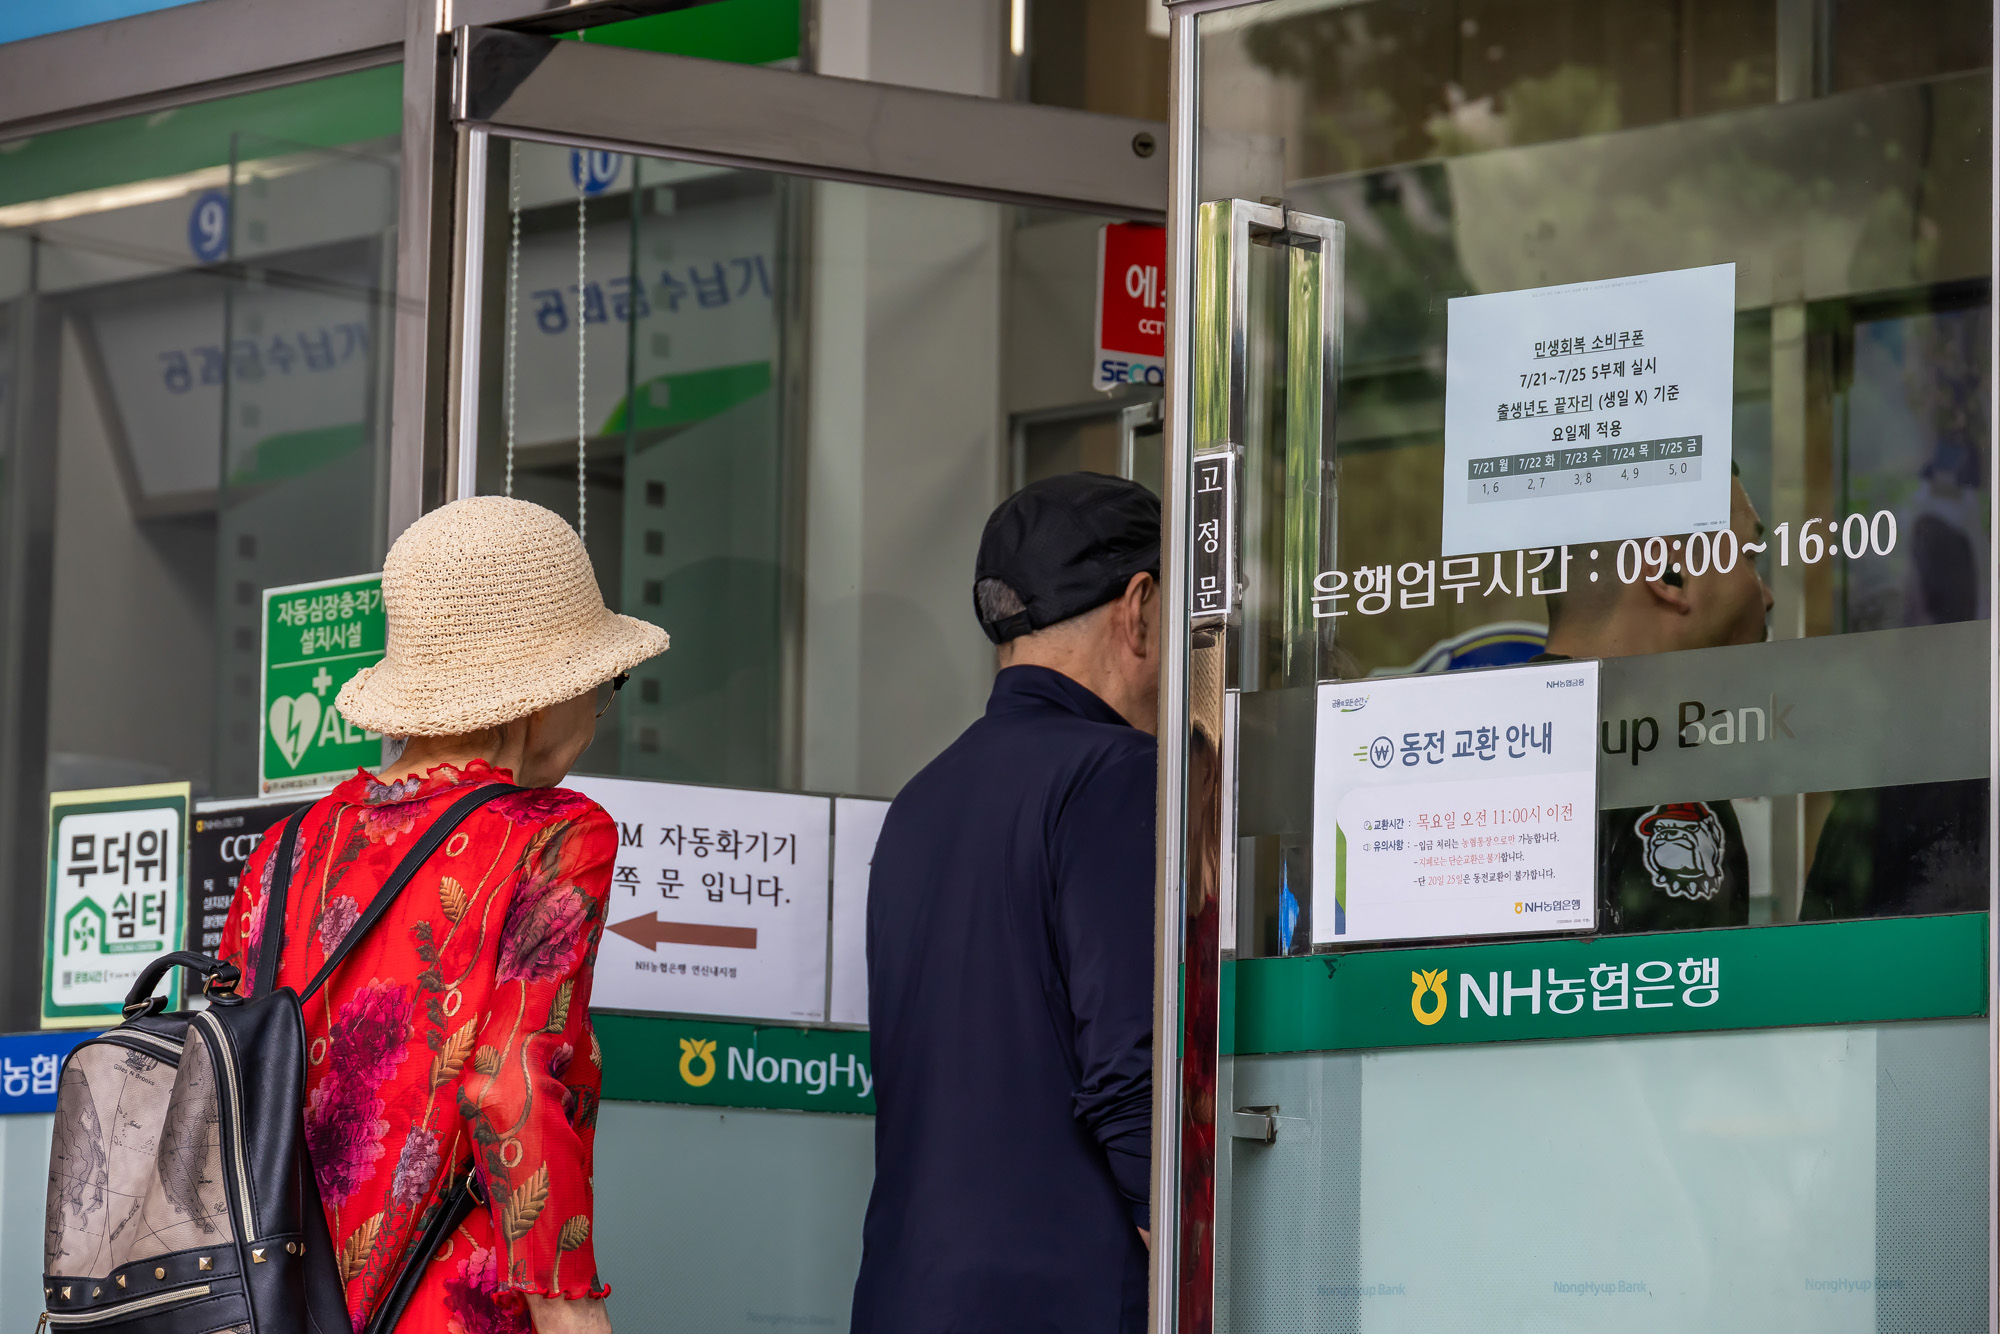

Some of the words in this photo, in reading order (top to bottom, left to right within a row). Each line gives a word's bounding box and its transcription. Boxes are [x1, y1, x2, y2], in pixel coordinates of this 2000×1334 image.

[199, 199, 224, 249] 9
[1125, 264, 1166, 309] 에
[1138, 319, 1165, 335] CCT
[1534, 336, 1586, 358] 민생회복
[1591, 329, 1644, 350] 소비쿠폰
[1101, 360, 1164, 385] SECO
[1520, 367, 1586, 389] 7/21~7/25
[1591, 360, 1625, 379] 5부제
[1631, 357, 1657, 376] 실시
[1497, 400, 1548, 420] 출생년도
[1554, 394, 1593, 413] 끝자리
[1599, 389, 1629, 410] (생일
[1634, 390, 1648, 409] X)
[1653, 384, 1680, 402] 기준
[1552, 423, 1590, 441] 요일제
[1596, 420, 1622, 437] 적용
[1473, 463, 1494, 475] 7/21
[1499, 459, 1509, 473] 월
[1519, 457, 1541, 470] 7/22
[1545, 455, 1556, 468] 화
[1565, 452, 1588, 466] 7/23
[1592, 449, 1602, 463] 수
[1612, 447, 1635, 460] 7/24
[1639, 444, 1649, 457] 목
[1660, 442, 1682, 455] 7/25
[1687, 439, 1697, 452] 금
[1311, 545, 1573, 618] 은행업무시간
[1616, 510, 1897, 584] 09:00~16:00
[277, 590, 385, 626] 자동심장충격기
[300, 621, 362, 655] 설치시설
[1546, 678, 1585, 689] NH농협금융
[318, 705, 382, 747] AE
[1678, 692, 1796, 748] Bank
[1400, 730, 1445, 766] 동전
[1452, 726, 1500, 761] 교환
[1506, 721, 1552, 759] 안내
[1373, 818, 1405, 830] 교환시간
[1417, 811, 1455, 831] 목요일
[1460, 809, 1487, 827] 오전
[1493, 805, 1541, 825] 11:00시
[1547, 802, 1573, 823] 이전
[67, 829, 167, 887] 무더위
[615, 821, 644, 848] M
[660, 824, 796, 865] 자동화기기
[1373, 840, 1404, 852] 유의사항
[1437, 838, 1459, 849] 처리는
[1461, 834, 1515, 848] 농협통장으로만
[1518, 832, 1560, 844] 가능합니다.
[613, 866, 641, 896] 쪽
[657, 869, 684, 899] 문
[702, 872, 790, 907] 입니다.
[1428, 875, 1444, 886] 20일
[112, 890, 166, 938] 쉼터
[1525, 899, 1580, 912] NH농협은행
[635, 961, 687, 975] NH농협은행
[1460, 957, 1719, 1018] NH농협은행
[0, 1053, 68, 1097] 농협
[727, 1047, 871, 1097] NongHy
